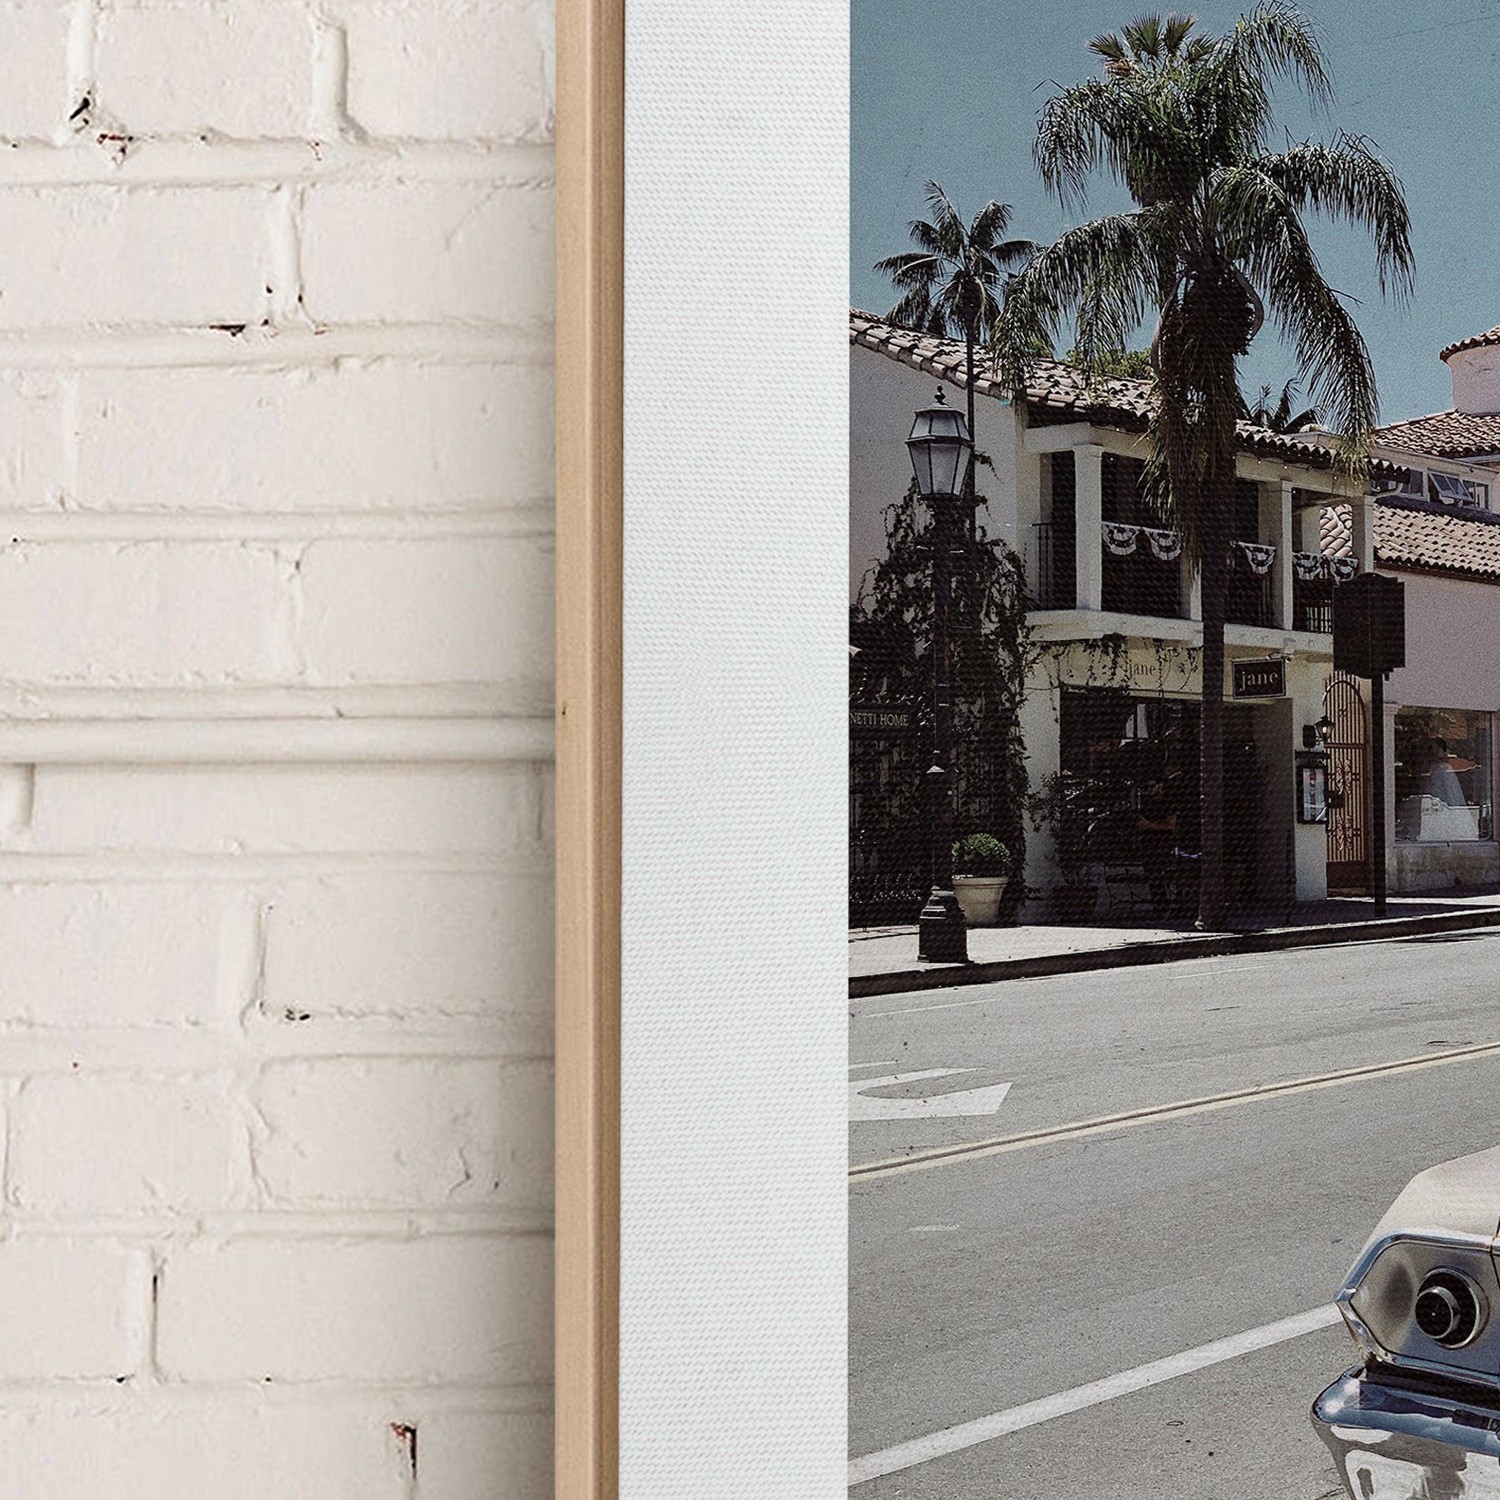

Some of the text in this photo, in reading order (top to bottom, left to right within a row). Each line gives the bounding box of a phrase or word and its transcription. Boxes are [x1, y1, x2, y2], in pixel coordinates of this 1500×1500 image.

[1128, 660, 1157, 679] jane
[1239, 670, 1279, 692] jane
[880, 713, 909, 727] HOME
